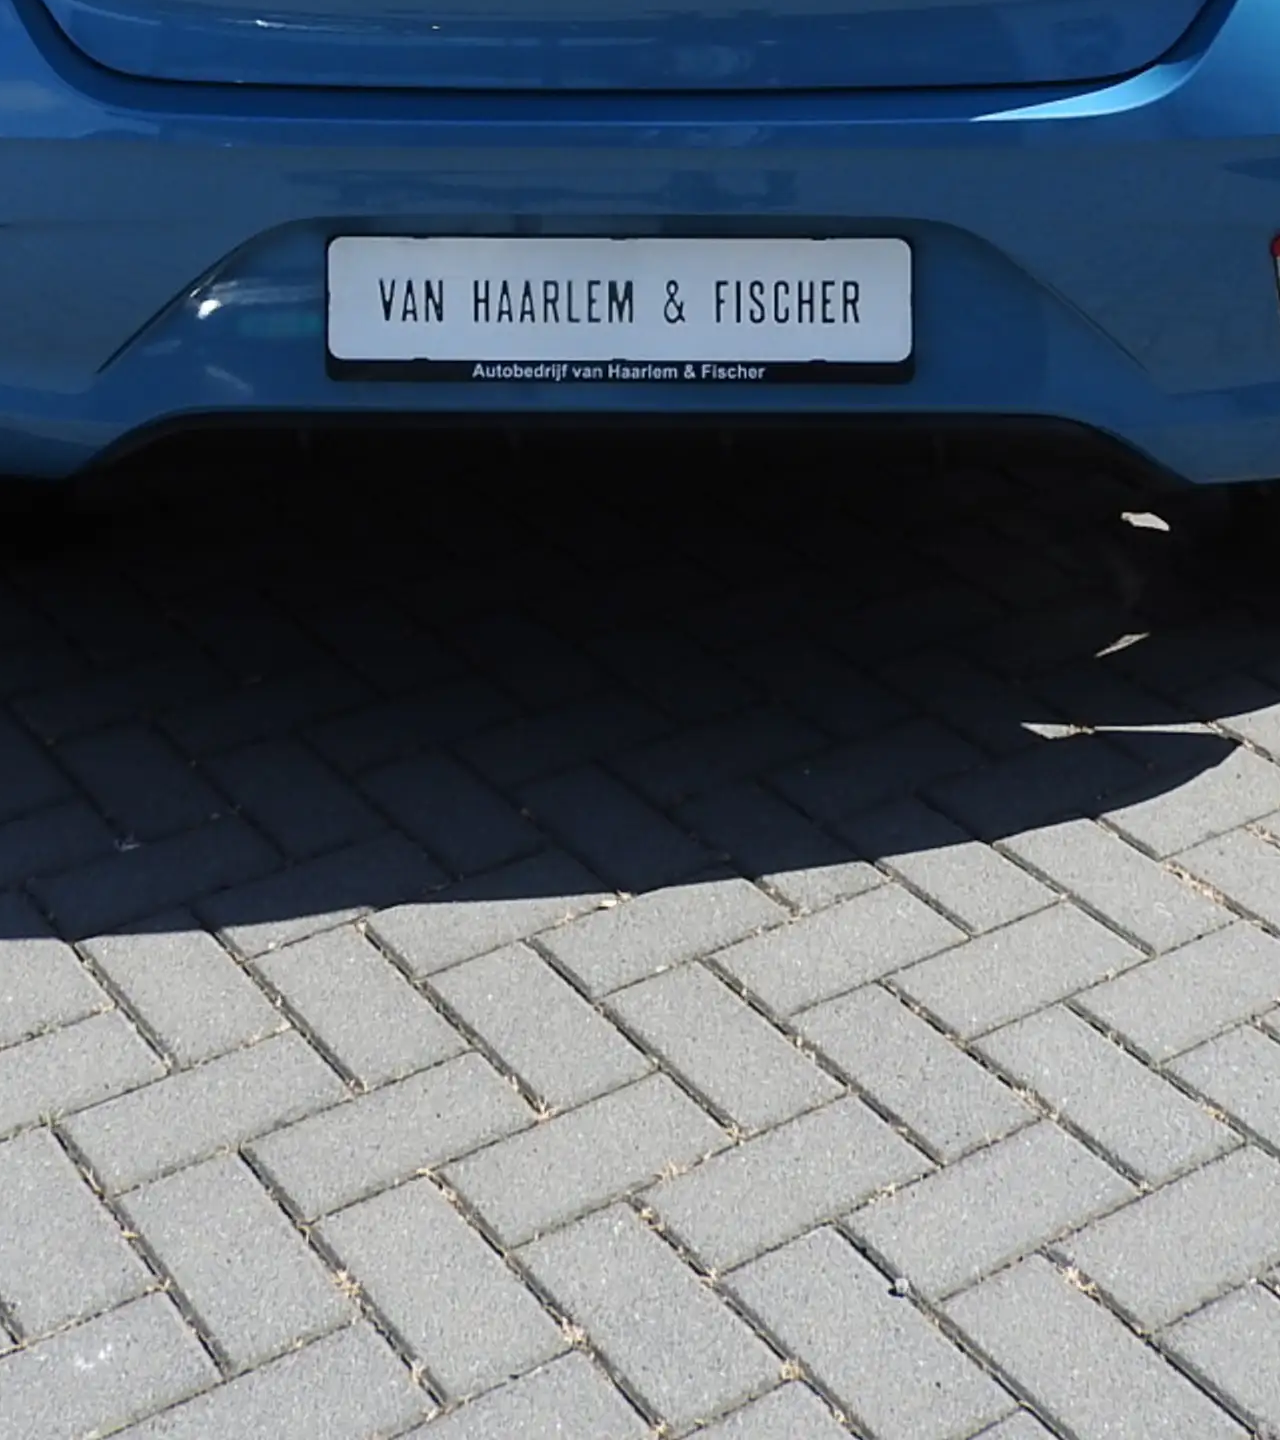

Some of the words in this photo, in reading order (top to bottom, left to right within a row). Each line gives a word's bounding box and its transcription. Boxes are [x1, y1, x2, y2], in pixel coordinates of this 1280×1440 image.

[378, 278, 444, 324] VAN
[472, 278, 634, 324] HAARLEM
[663, 279, 686, 324] &
[714, 279, 860, 324] FISCHER
[472, 363, 569, 381] Autobedrijf
[571, 366, 603, 379] van
[607, 363, 678, 379] Haarlem
[683, 363, 697, 379] &
[701, 363, 766, 379] Fischer
